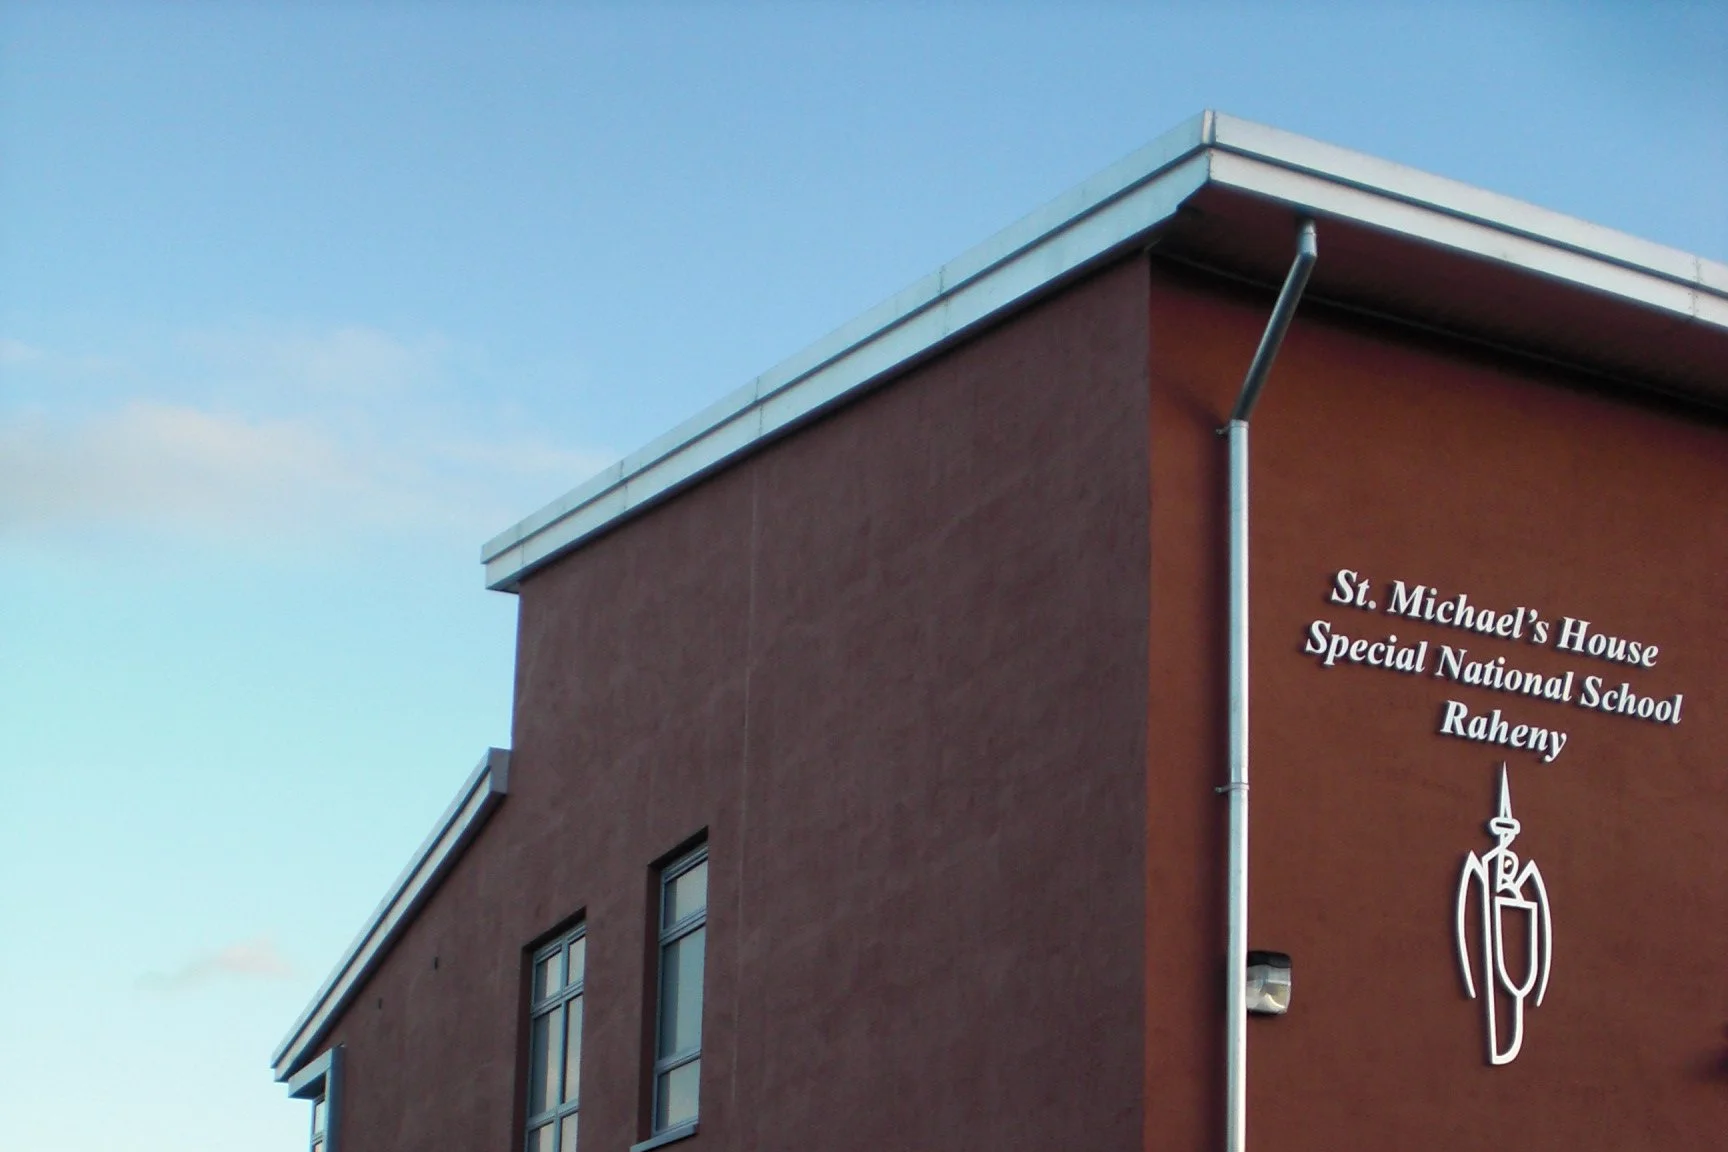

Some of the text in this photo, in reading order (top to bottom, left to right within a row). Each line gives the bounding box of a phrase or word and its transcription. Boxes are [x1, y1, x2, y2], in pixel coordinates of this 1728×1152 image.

[1331, 568, 1660, 668] St. Michael's House
[1305, 619, 1684, 725] Special National School
[1440, 699, 1568, 763] Raheny
